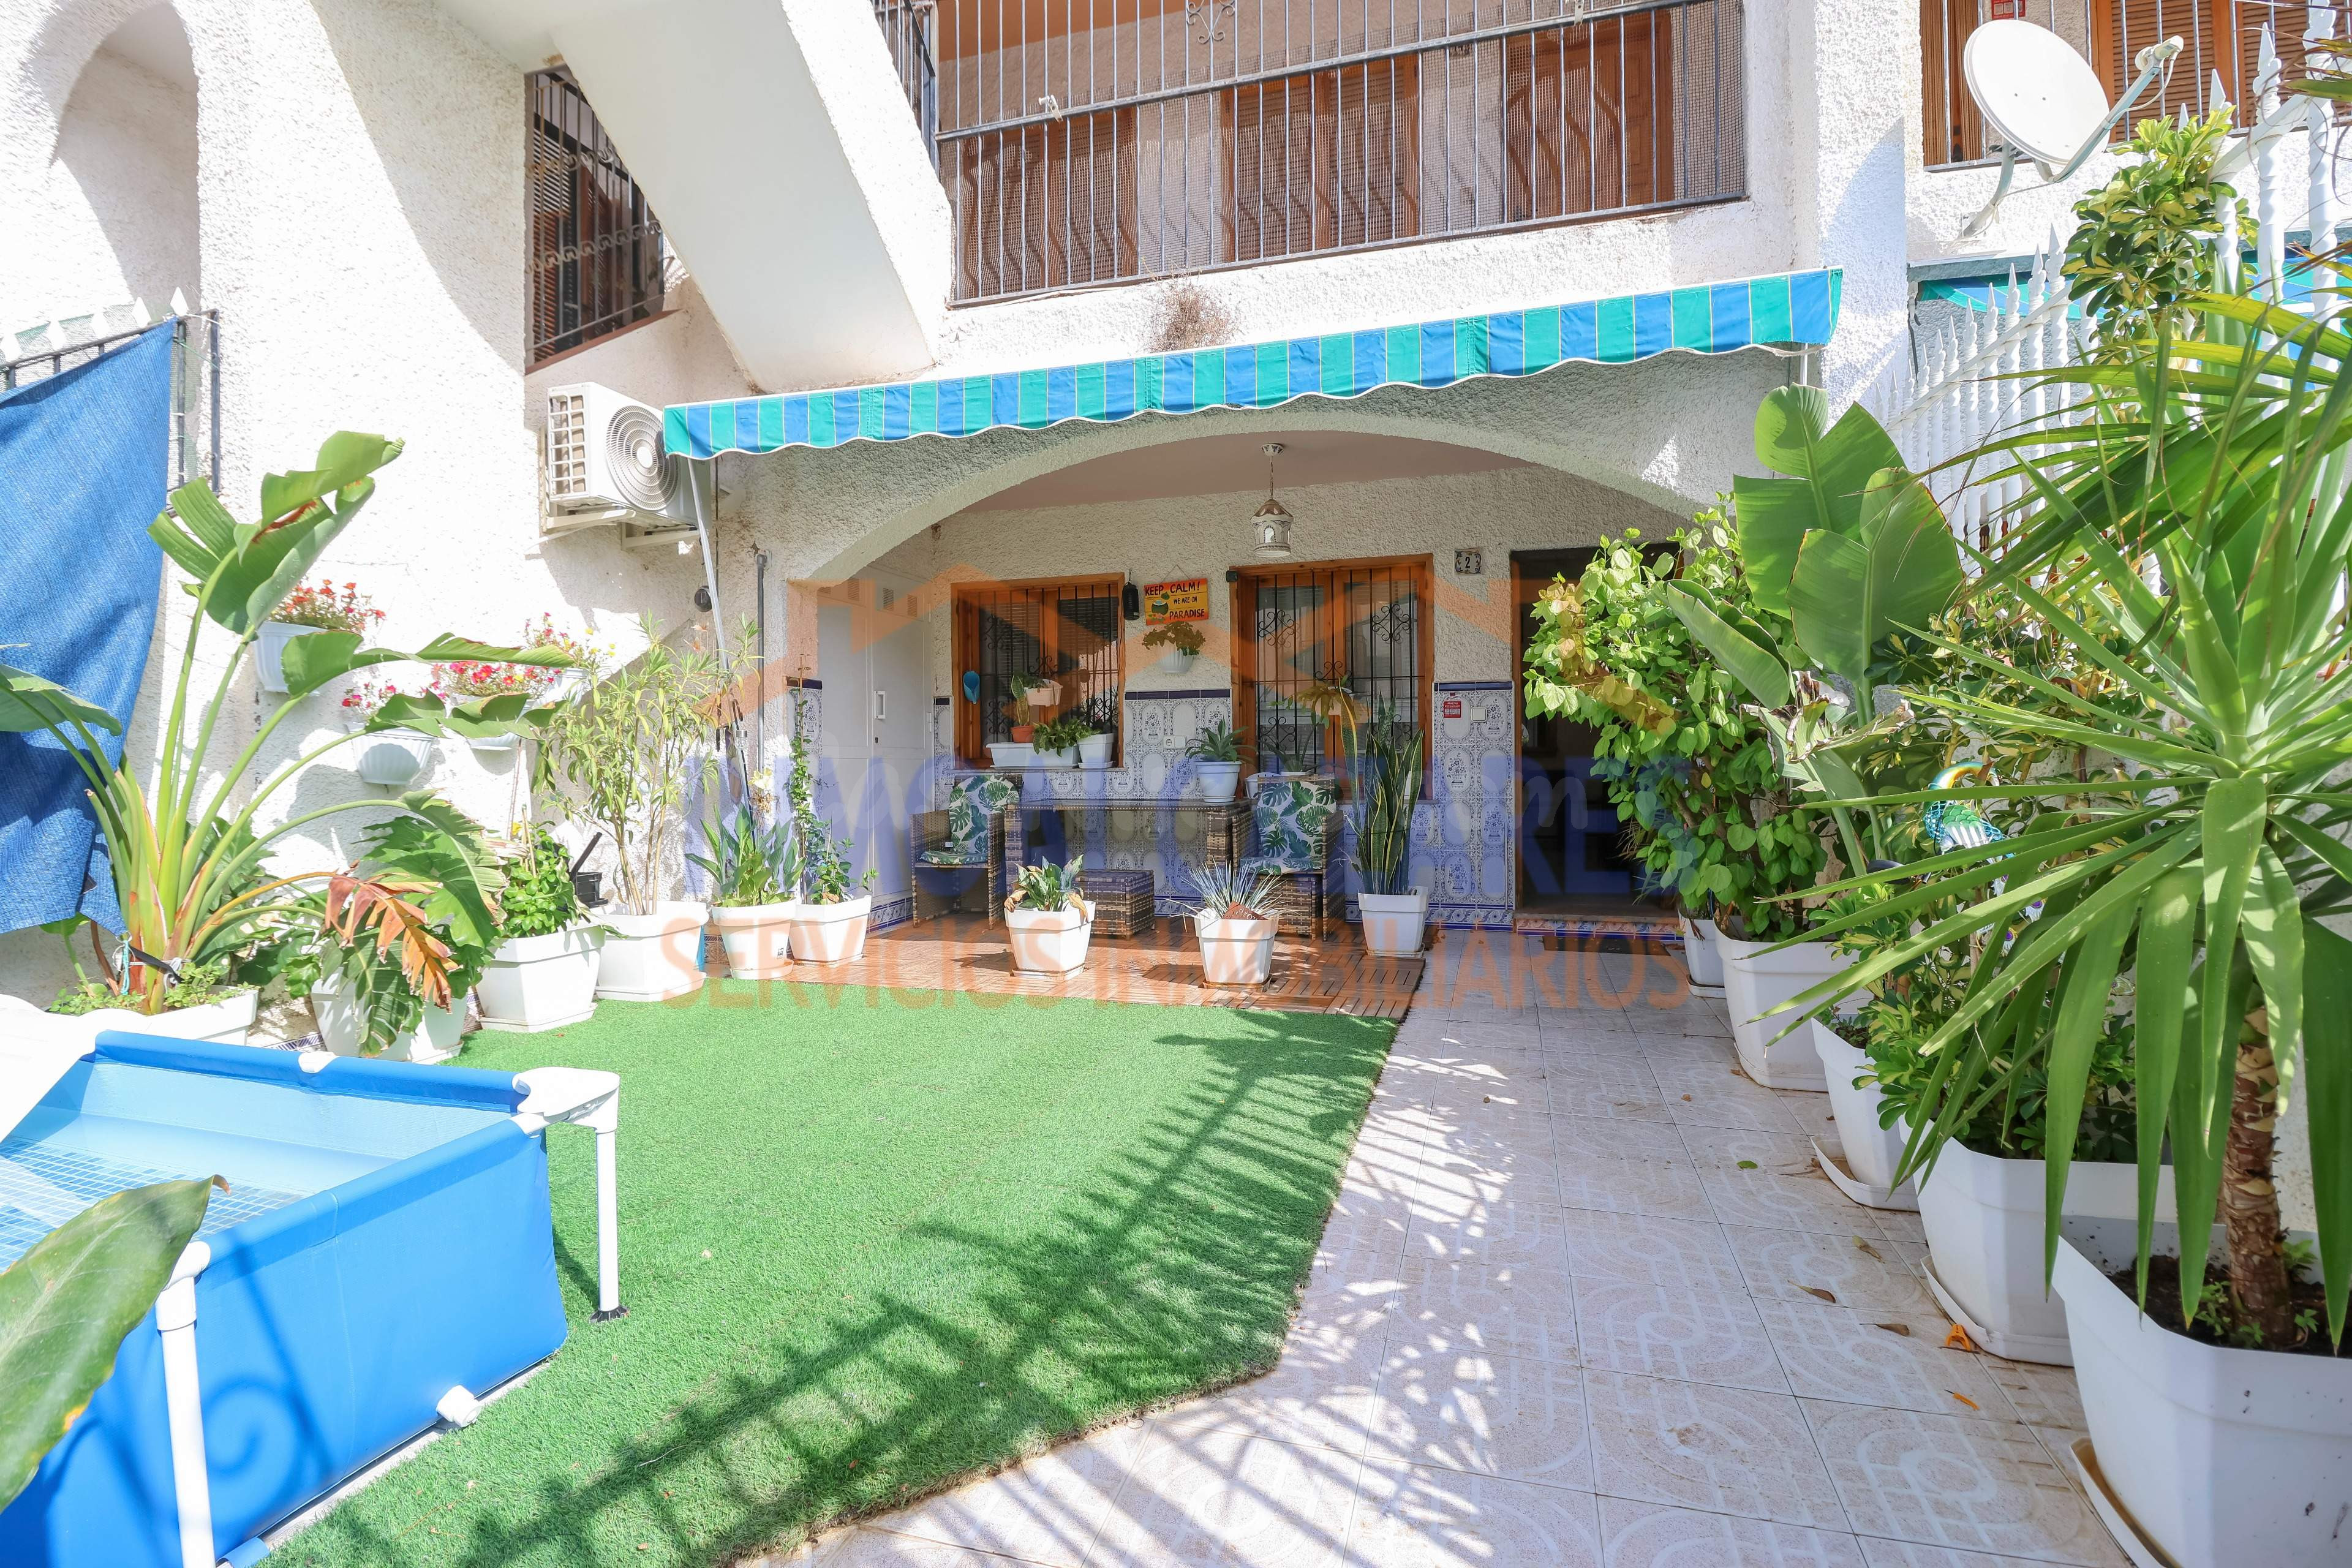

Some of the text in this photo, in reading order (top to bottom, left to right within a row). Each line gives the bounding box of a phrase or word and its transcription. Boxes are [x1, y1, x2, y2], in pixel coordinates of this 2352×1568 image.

[1465, 556, 1471, 569] 2
[1145, 581, 1200, 597] KEEP CALM!
[1169, 608, 1205, 620] PARADISE
